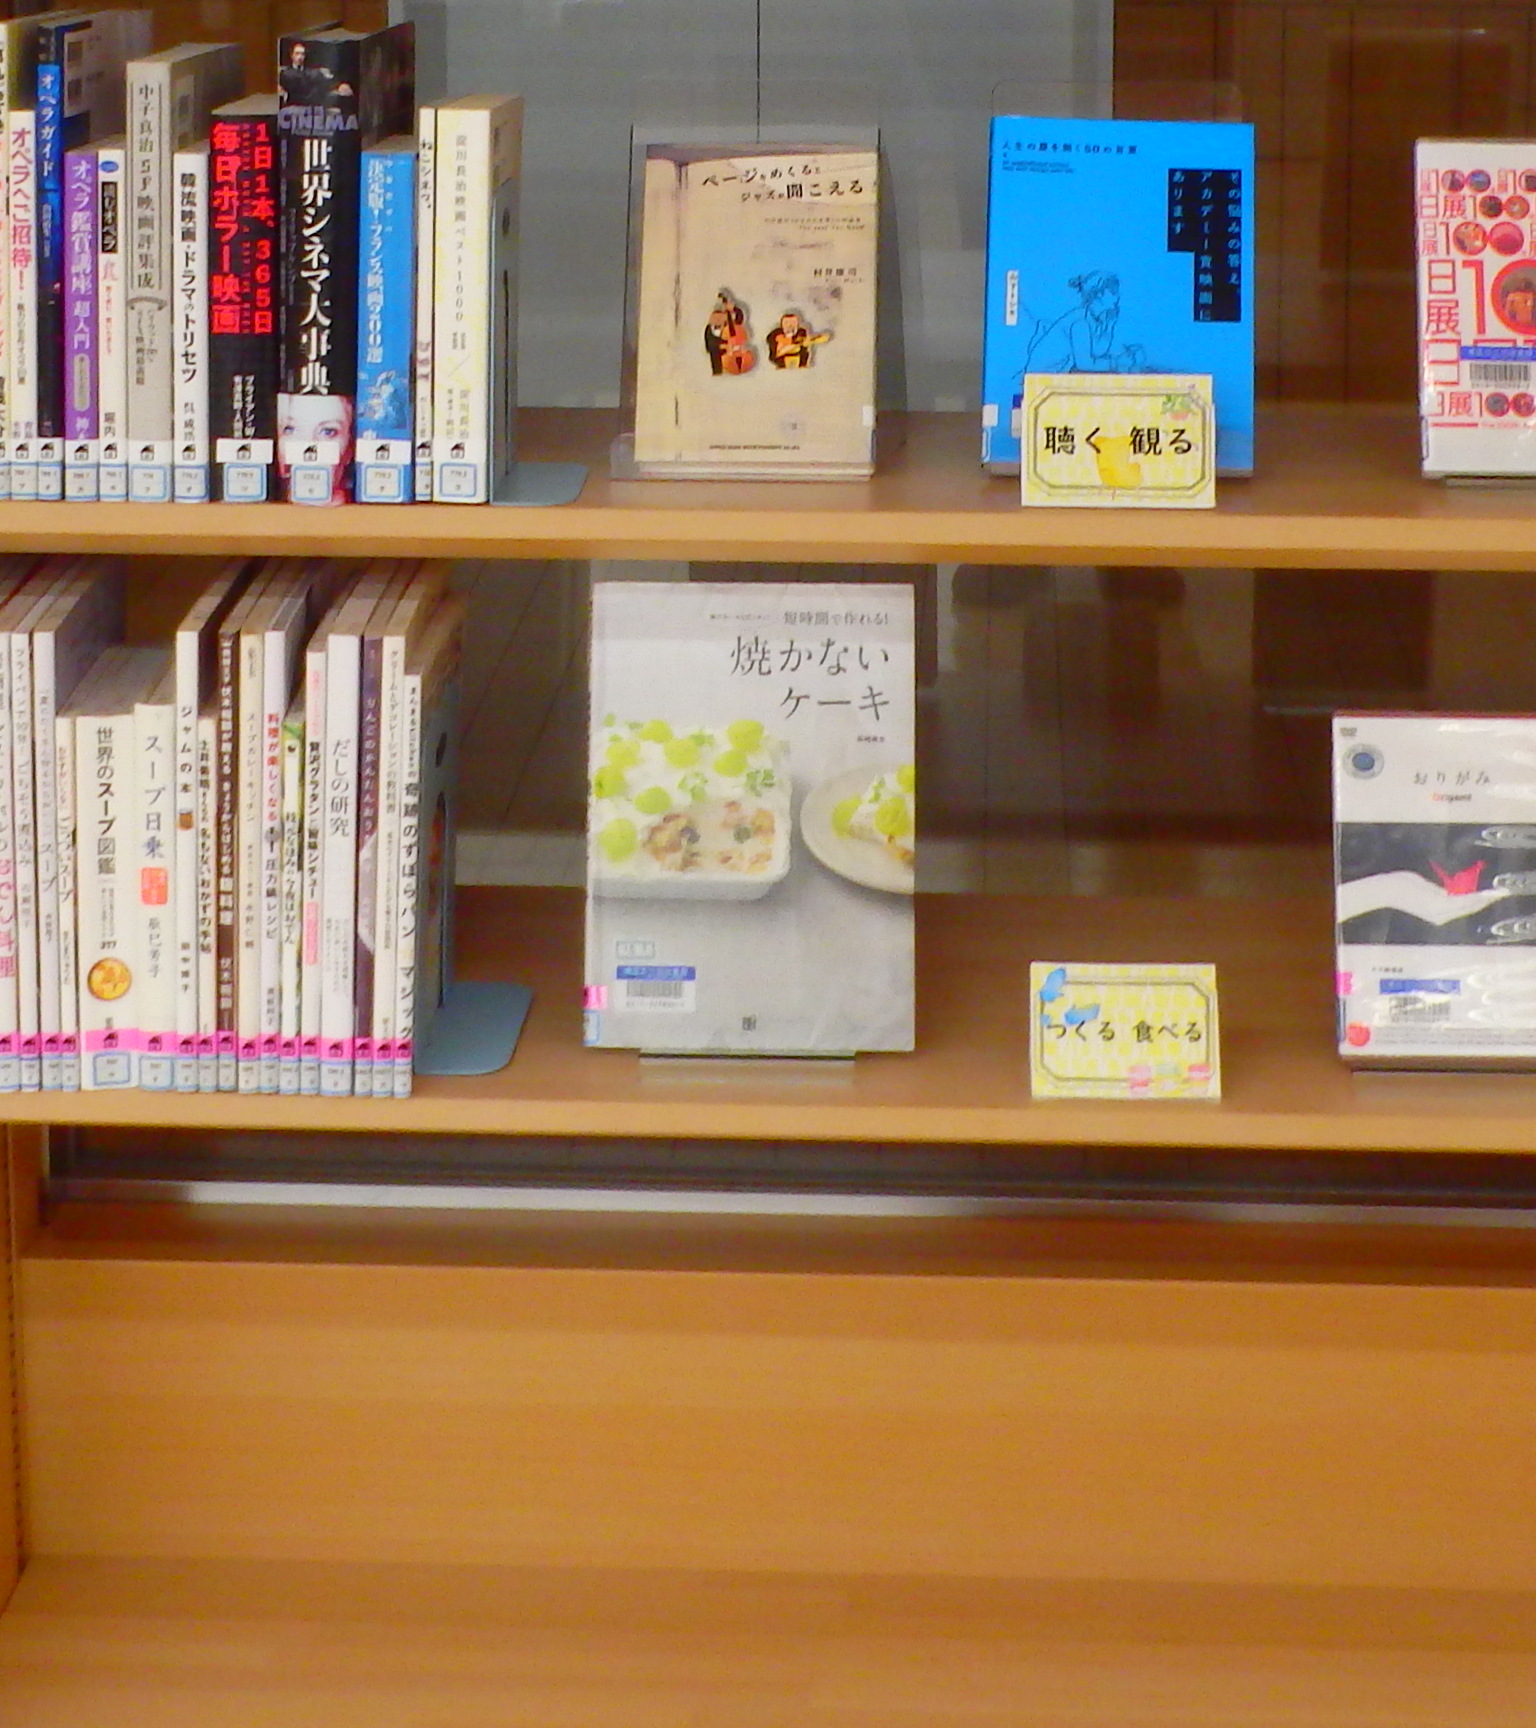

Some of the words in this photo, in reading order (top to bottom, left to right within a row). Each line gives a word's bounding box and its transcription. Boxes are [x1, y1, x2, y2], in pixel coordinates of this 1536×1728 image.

[40, 73, 57, 177] オペラガイド
[212, 122, 242, 334] 毎日ホラー映画
[1173, 171, 1185, 235] あります
[180, 173, 197, 383] 韓流映画・ドラマのトリセツ
[300, 138, 333, 396] 世界シネマ大事典
[1044, 426, 1102, 455] 聴く
[1130, 426, 1194, 455] 観る
[730, 635, 891, 677] 焼かない
[180, 705, 193, 794] ジャムの本
[780, 686, 891, 722] ケーキ
[96, 726, 117, 875] 世界のスープ図鑑
[329, 739, 351, 838] だしの研究
[1047, 1021, 1116, 1042] つくる
[1132, 1019, 1203, 1044] 食べる
